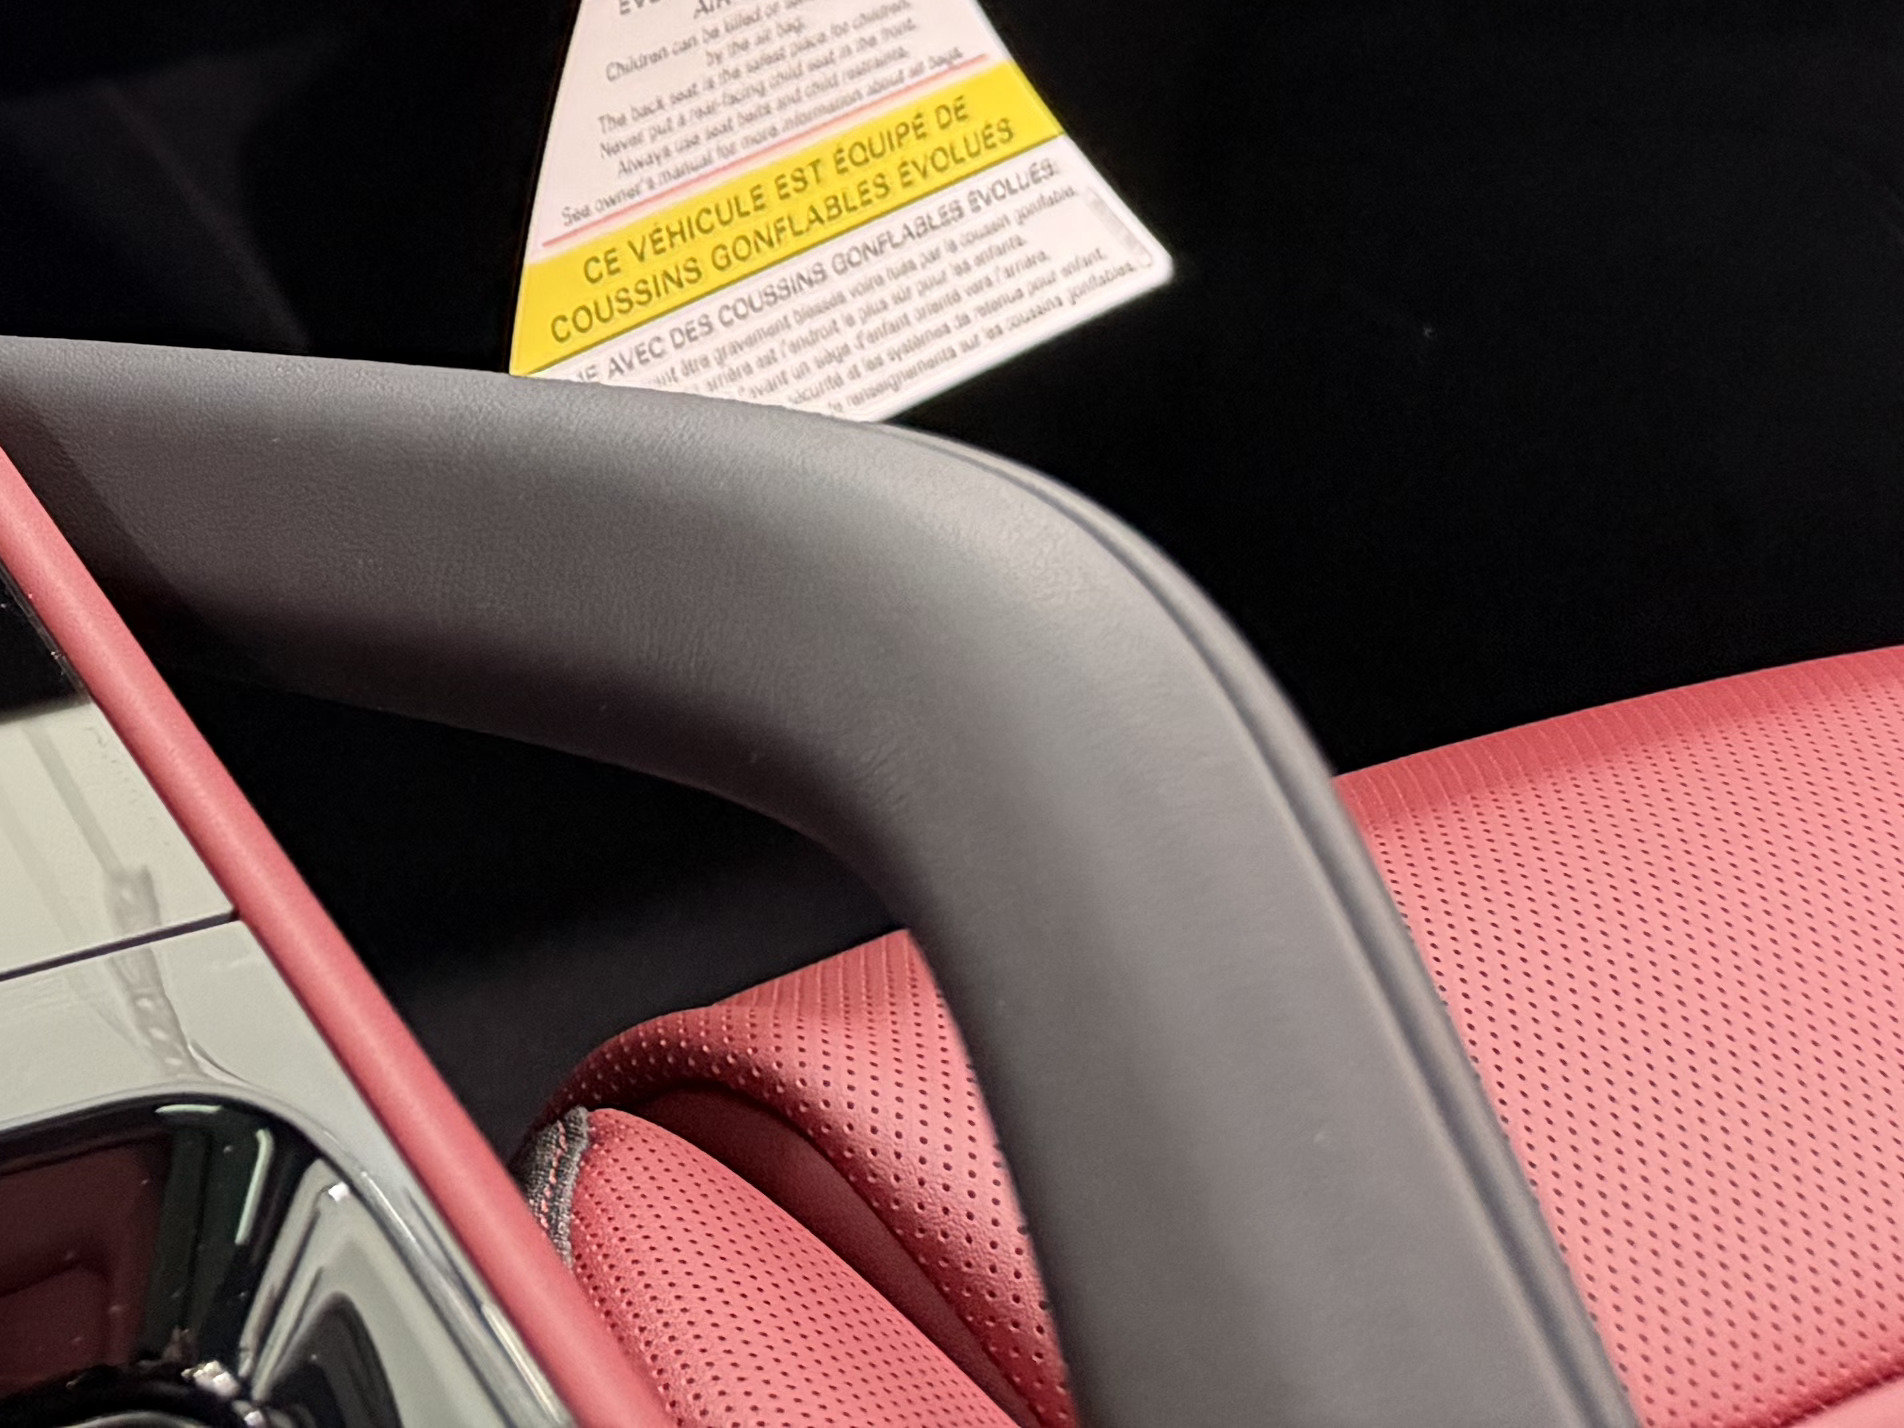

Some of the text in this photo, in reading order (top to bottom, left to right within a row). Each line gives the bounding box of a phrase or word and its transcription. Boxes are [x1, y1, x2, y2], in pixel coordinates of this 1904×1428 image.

[551, 118, 1014, 343] COUSSINS GONFLABLES ÉVOLUÉS
[584, 96, 969, 284] CE VÉHICULE EST ÉQUIPÉ DE
[609, 336, 665, 378] AVEC
[670, 314, 714, 350] DES
[718, 262, 828, 328] COUSSINS
[832, 200, 964, 275] GONFLABLES
